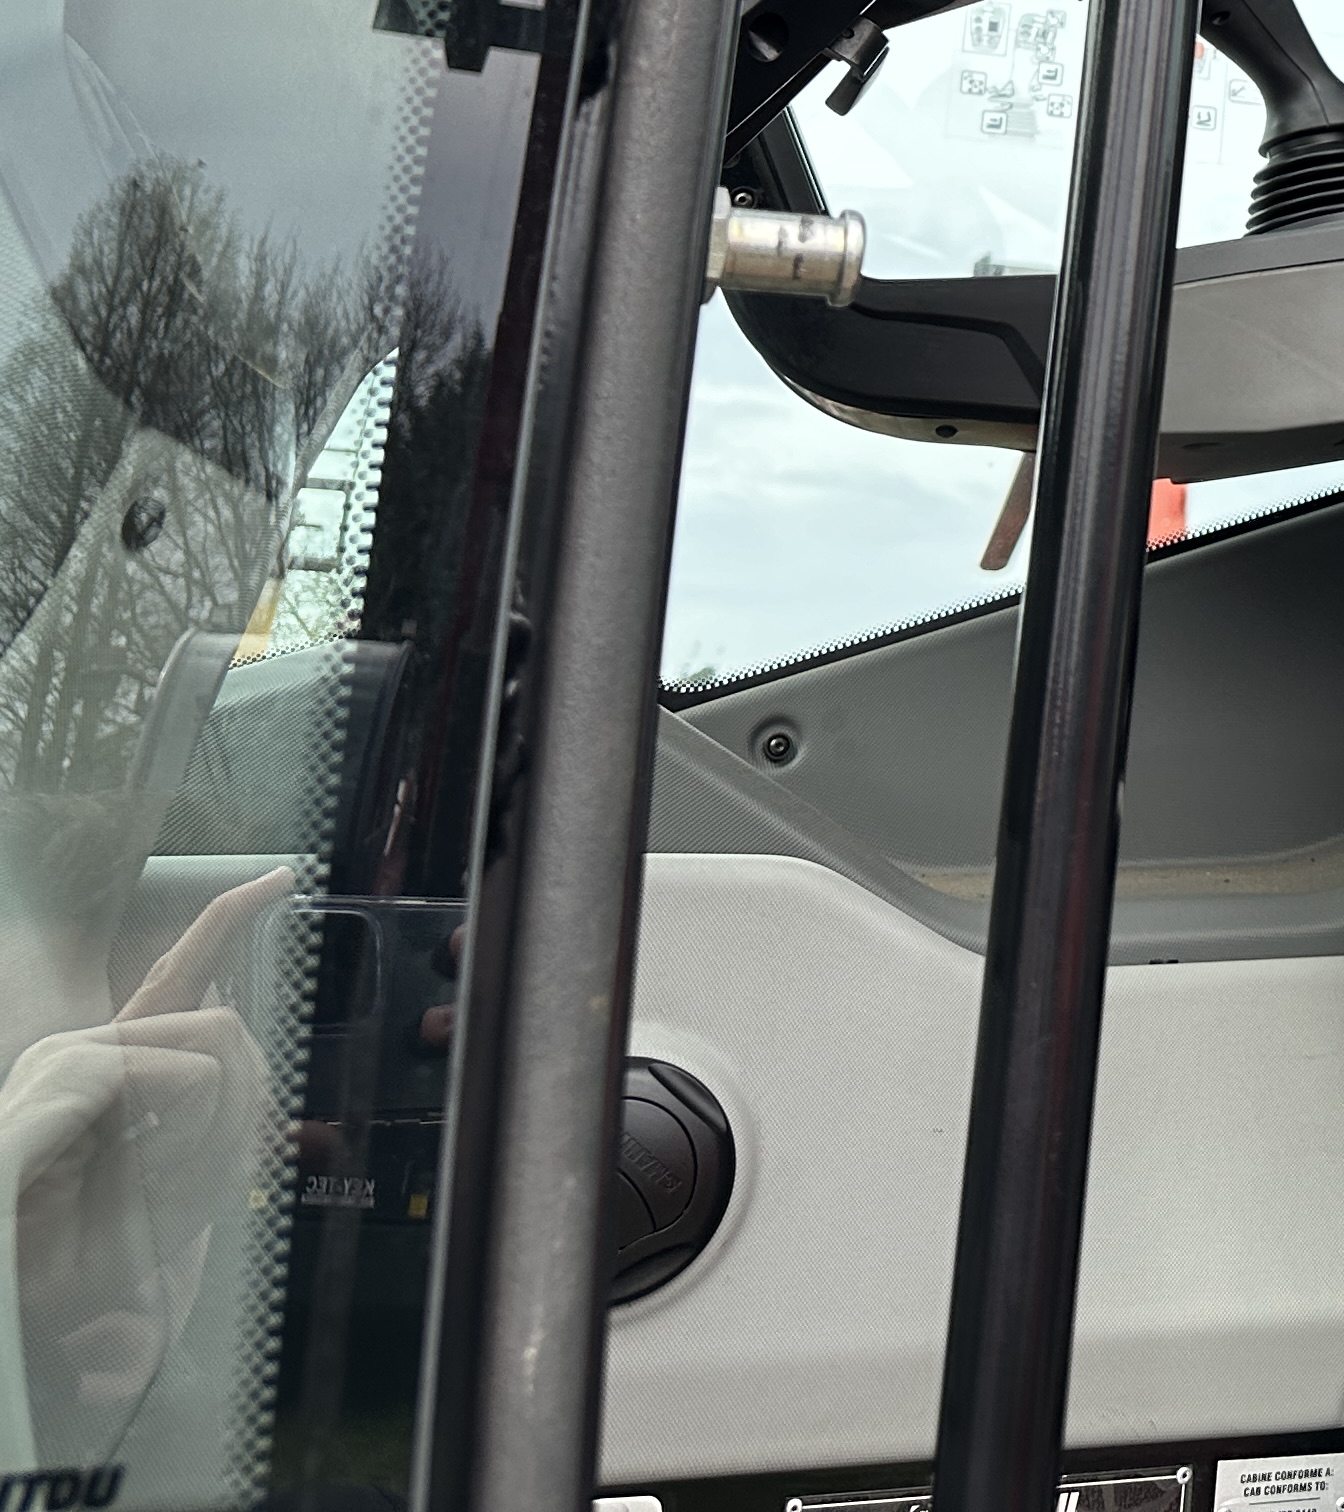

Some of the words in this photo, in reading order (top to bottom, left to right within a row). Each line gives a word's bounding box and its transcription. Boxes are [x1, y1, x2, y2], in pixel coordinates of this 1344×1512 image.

[1240, 1471, 1272, 1484] CABINE
[1275, 1468, 1323, 1481] CONFORME
[1244, 1486, 1261, 1497] CAB
[1264, 1482, 1312, 1496] CONFORMS
